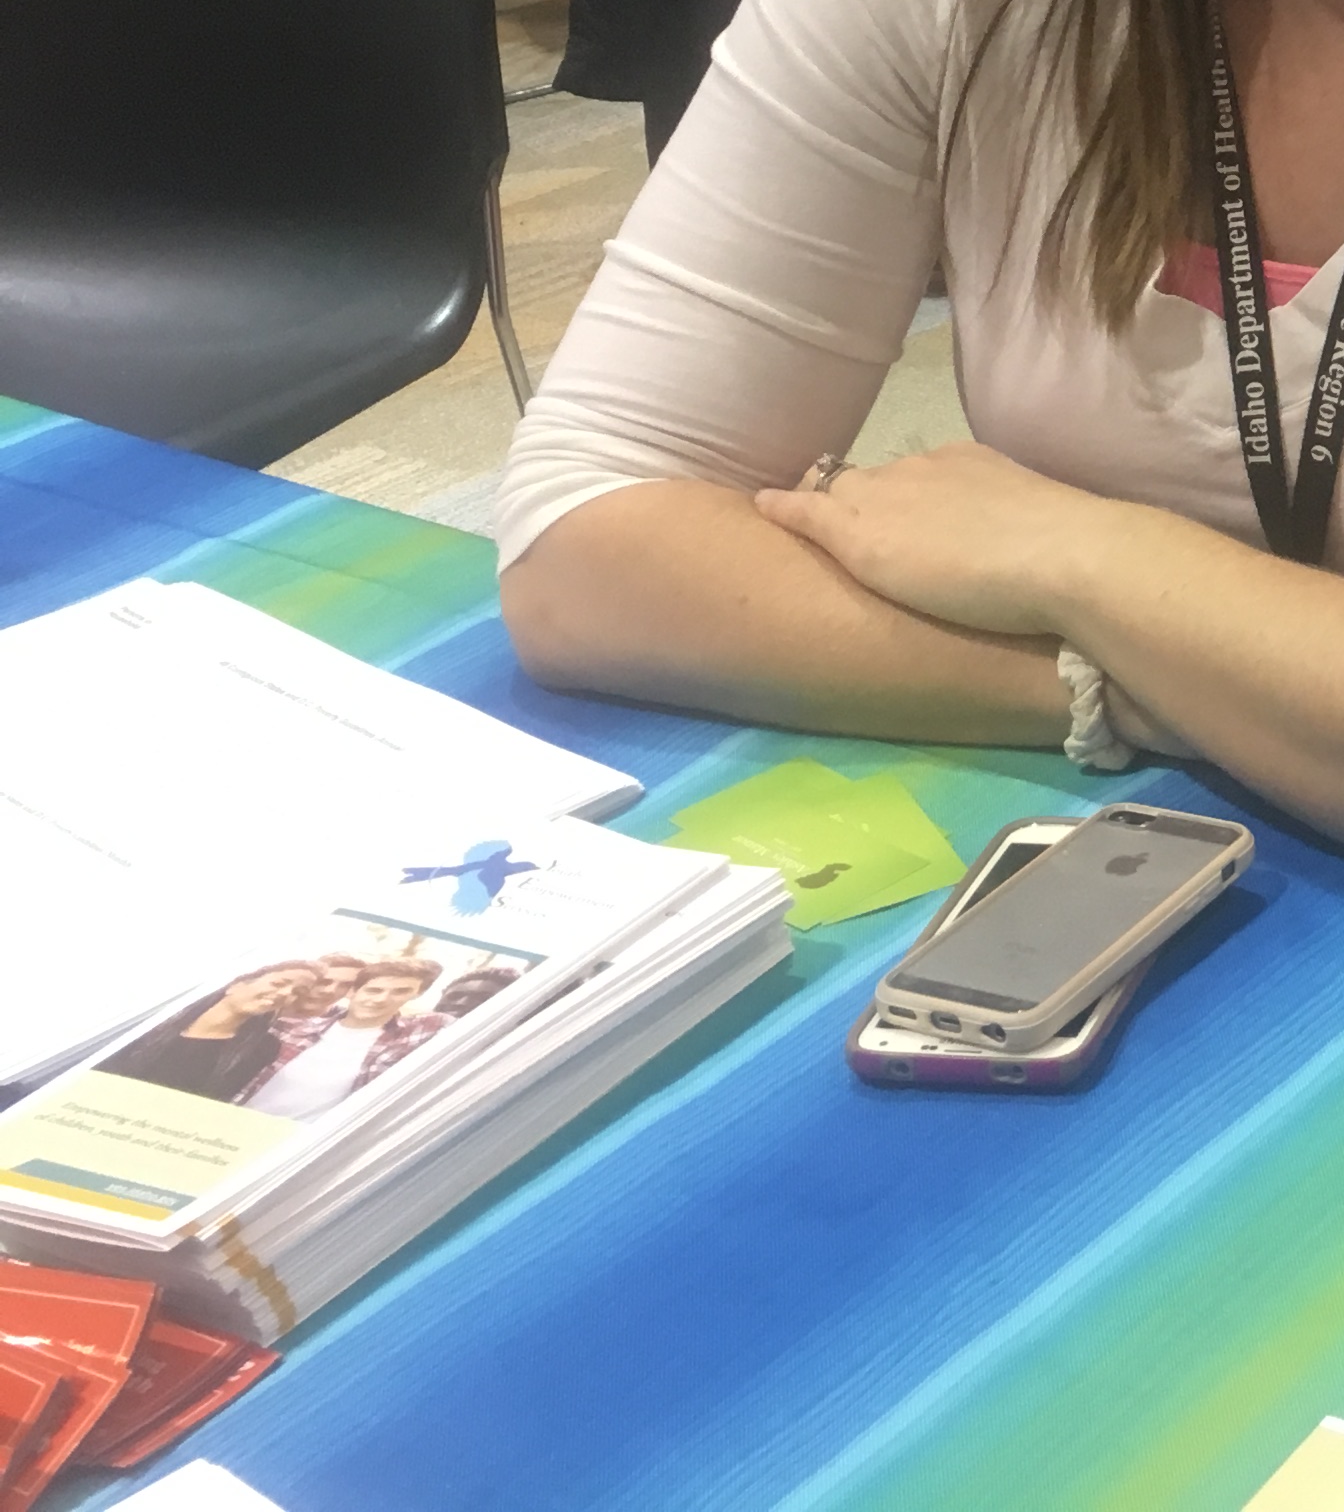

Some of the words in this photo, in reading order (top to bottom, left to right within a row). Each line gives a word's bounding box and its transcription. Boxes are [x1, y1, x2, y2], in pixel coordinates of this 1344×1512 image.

[1211, 59, 1237, 154] Health
[1216, 162, 1240, 191] of
[1222, 198, 1264, 374] Department
[1242, 382, 1272, 464] Idaho
[1310, 444, 1333, 464] 6
[34, 1112, 52, 1121] of
[94, 1128, 133, 1143] youth
[131, 1135, 159, 1148] and
[154, 1140, 185, 1156] their
[183, 1146, 230, 1167] families
[62, 1101, 132, 1126] Empowering
[130, 1119, 152, 1130] the
[153, 1124, 197, 1141] mental
[194, 1131, 240, 1152] wellness
